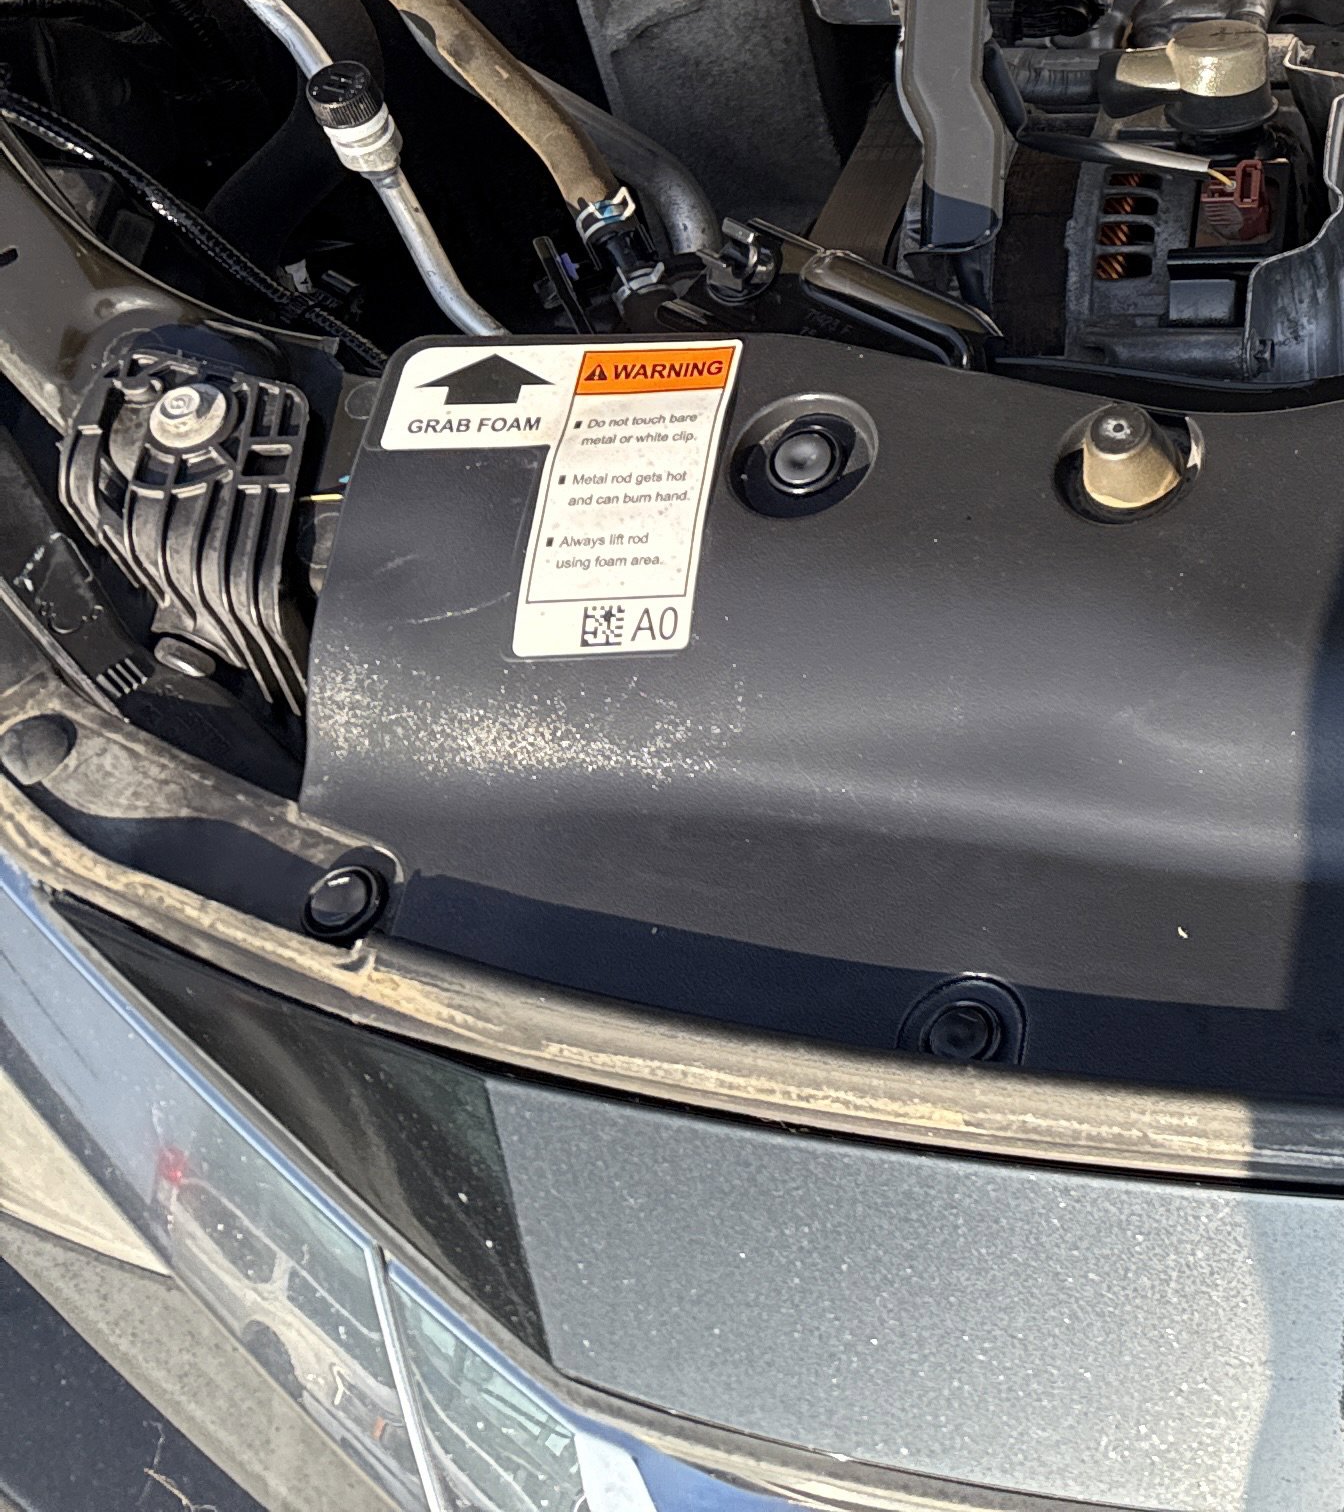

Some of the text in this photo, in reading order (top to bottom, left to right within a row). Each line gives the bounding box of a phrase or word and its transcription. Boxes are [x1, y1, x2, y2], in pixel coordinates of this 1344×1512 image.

[613, 360, 724, 380] WARNING
[407, 416, 542, 435] GRAB FOAM
[587, 412, 698, 429] Do not touch bare
[581, 431, 697, 446] metal or white clip.
[572, 470, 687, 487] Metal rod gets hot
[568, 490, 691, 507] and can burn hand.
[559, 532, 649, 549] Always lift rod
[556, 554, 664, 570] using foam area.
[630, 606, 679, 642] A0
